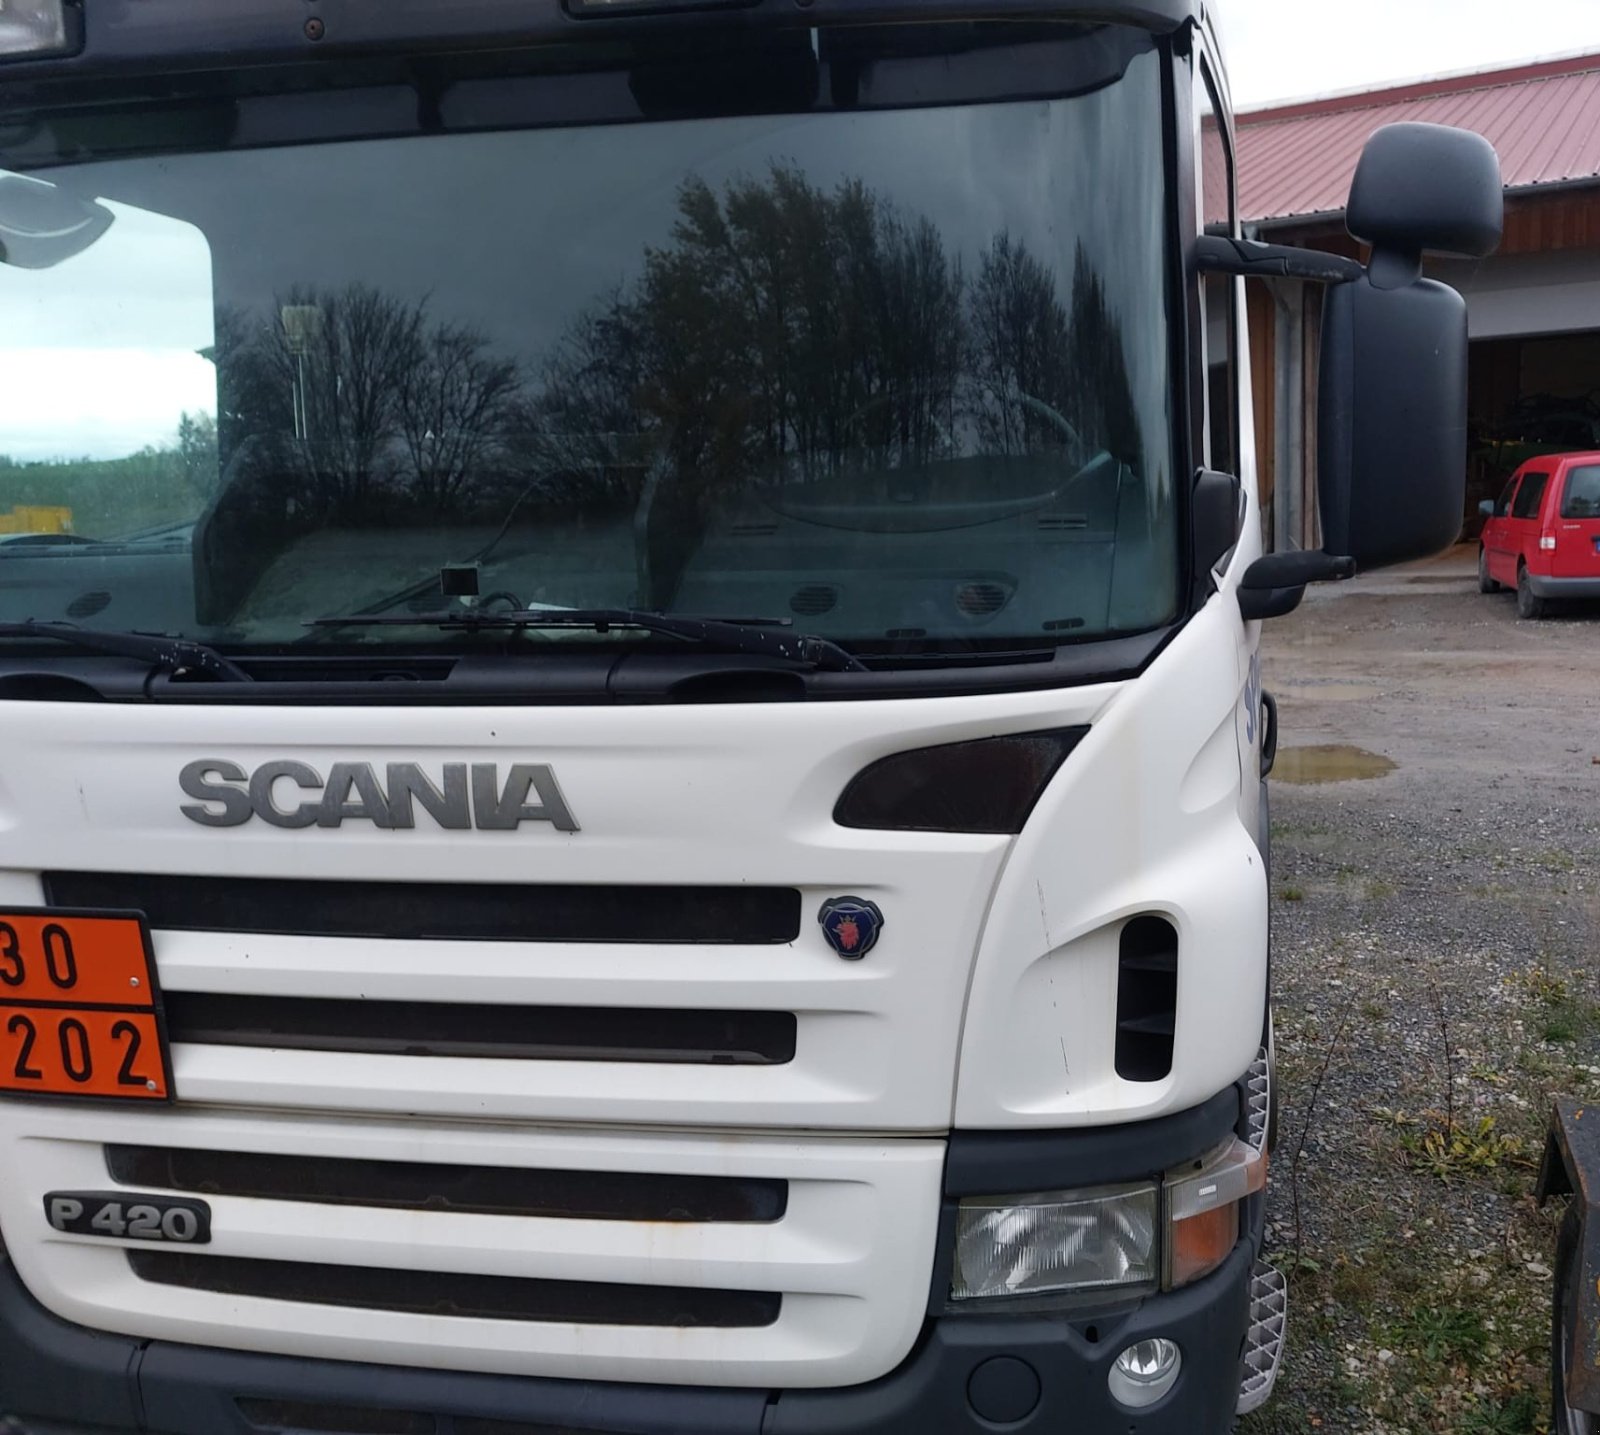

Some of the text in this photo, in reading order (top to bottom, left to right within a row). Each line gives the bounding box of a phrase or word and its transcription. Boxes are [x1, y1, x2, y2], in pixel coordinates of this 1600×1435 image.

[178, 759, 581, 831] SCANIA
[0, 922, 77, 989] 30
[7, 1014, 148, 1086] 202
[51, 1198, 198, 1241] P 420
